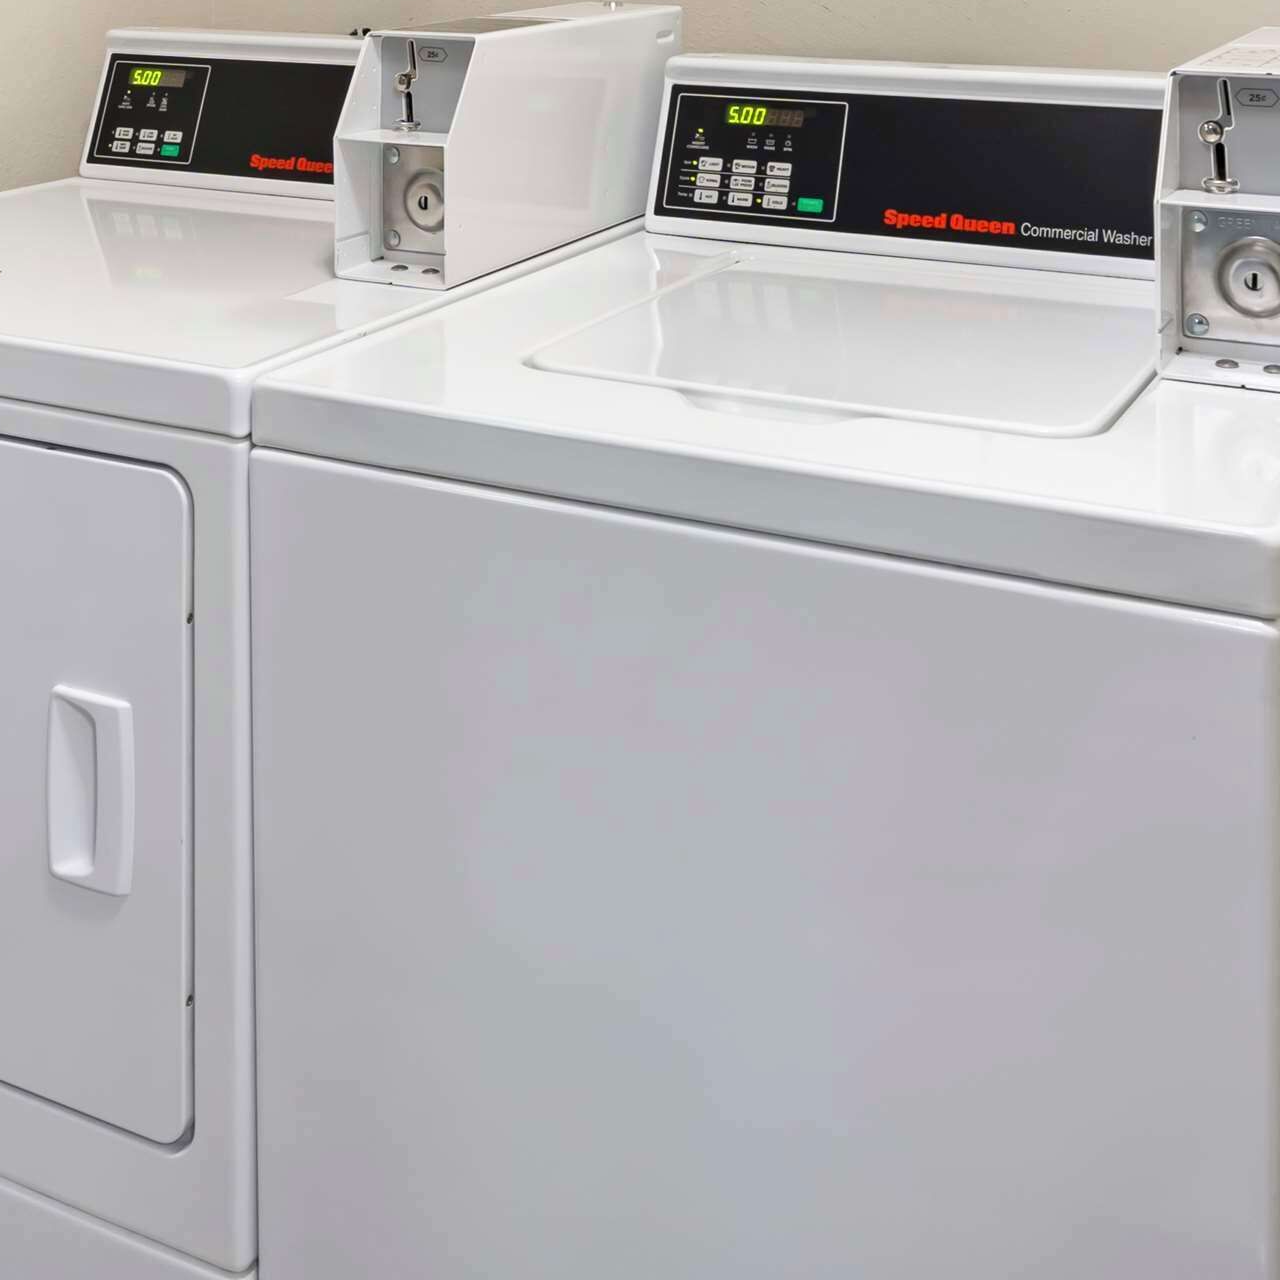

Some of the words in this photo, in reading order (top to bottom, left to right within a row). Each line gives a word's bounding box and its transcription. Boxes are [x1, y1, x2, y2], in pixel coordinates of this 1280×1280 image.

[132, 70, 161, 86] 5.00
[728, 106, 767, 125] 5.00
[250, 153, 295, 172] Speed
[296, 157, 333, 174] Quee
[883, 208, 947, 229] Speed
[950, 213, 1015, 235] Queen
[1021, 222, 1099, 243] Commercial
[1102, 228, 1153, 248] Washer
